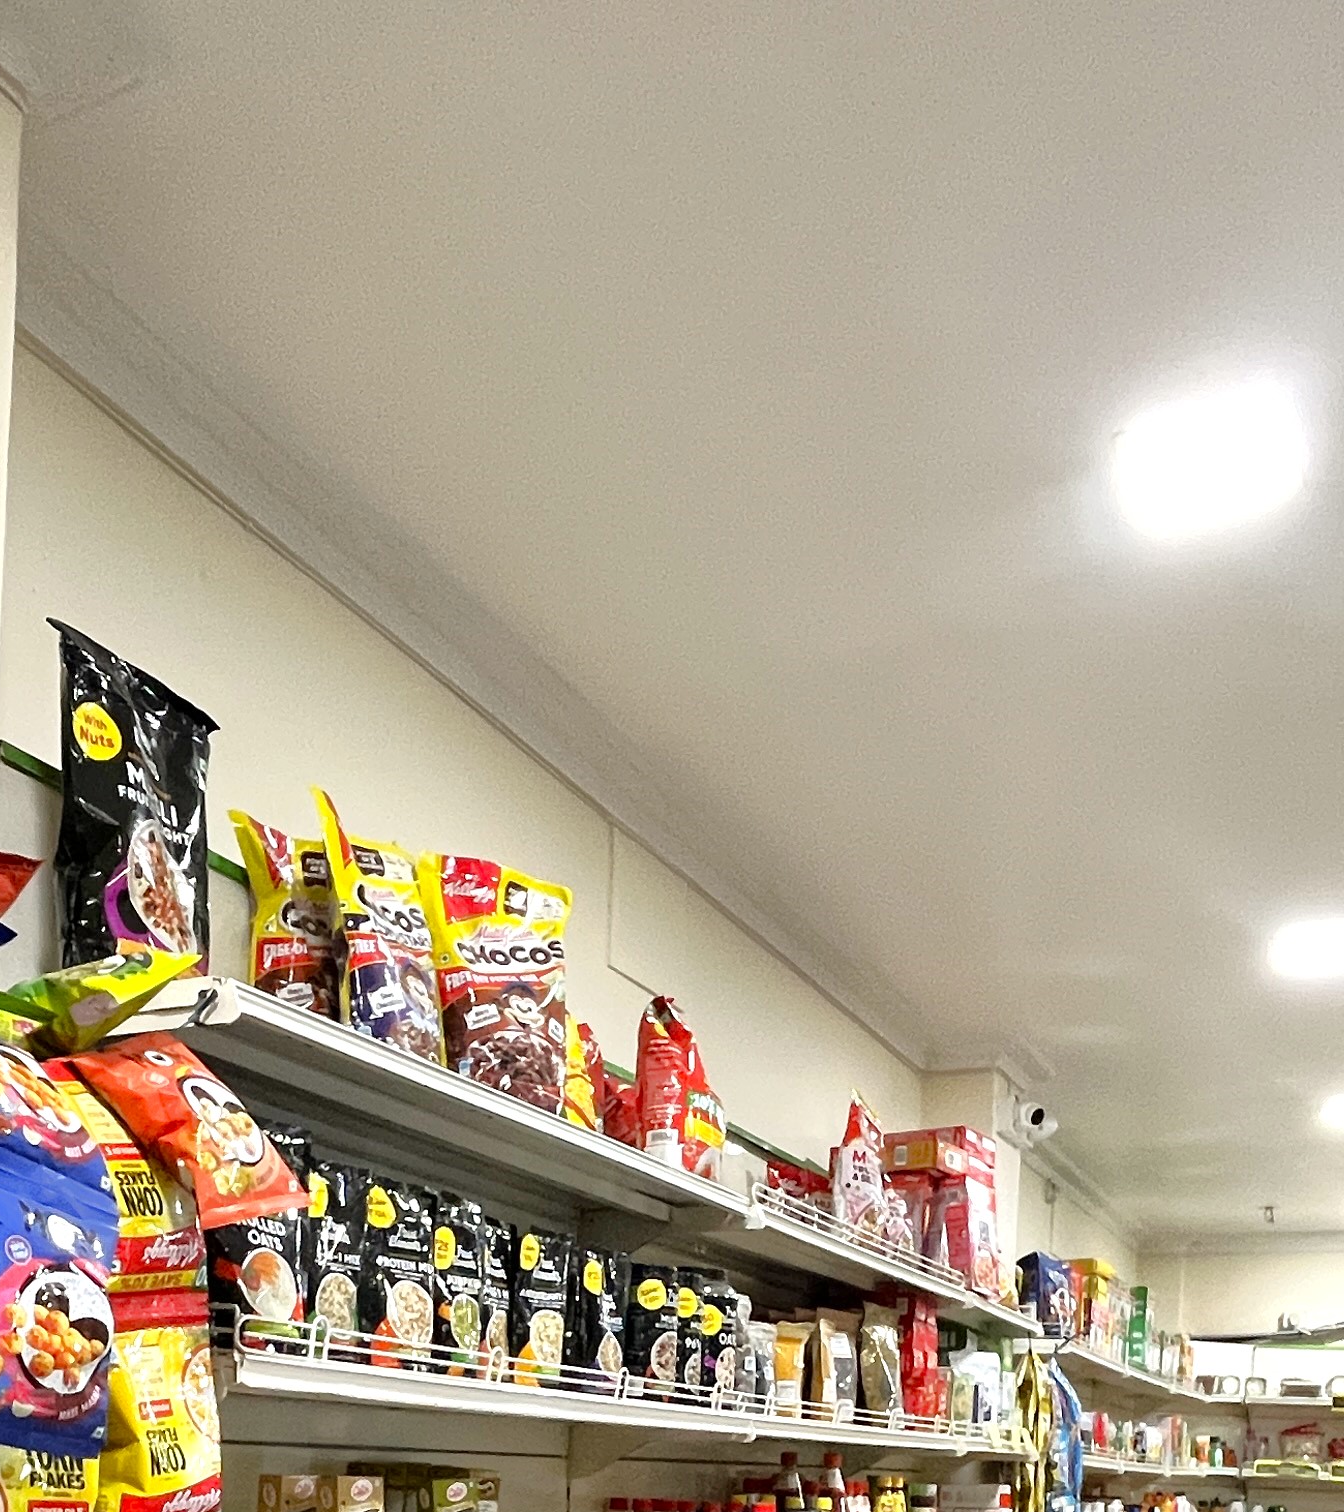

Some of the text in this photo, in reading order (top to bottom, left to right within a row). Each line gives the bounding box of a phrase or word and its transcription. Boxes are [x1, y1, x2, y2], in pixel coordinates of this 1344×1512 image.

[83, 711, 108, 730] With
[79, 726, 116, 749] Nuts
[456, 939, 566, 966] CHOCOS
[119, 1185, 164, 1218] CORN
[247, 1231, 284, 1252] OATS
